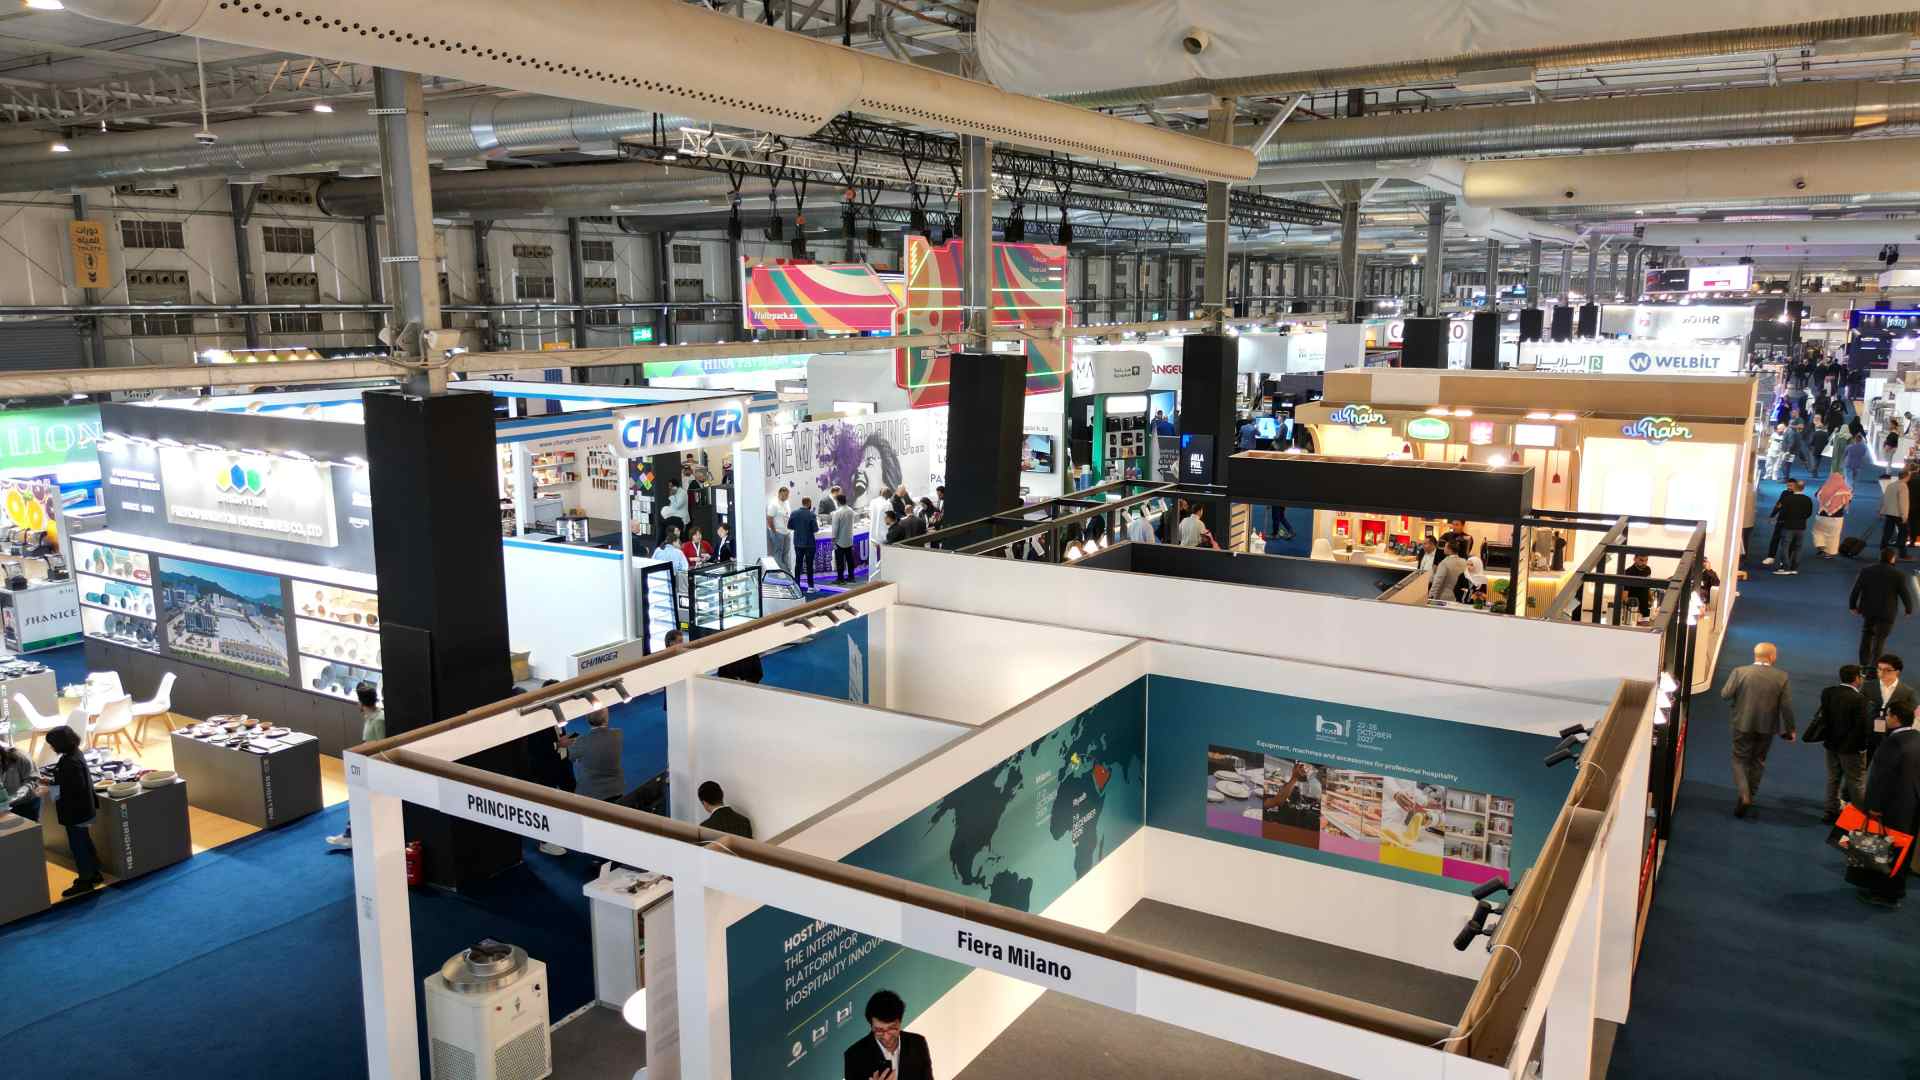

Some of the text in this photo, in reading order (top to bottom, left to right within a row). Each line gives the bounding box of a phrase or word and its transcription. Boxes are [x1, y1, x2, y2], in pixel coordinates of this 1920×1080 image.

[622, 408, 743, 449] CHANGER
[764, 428, 813, 477] NEW
[25, 609, 77, 626] SHANICE
[580, 650, 618, 669] CHANGER
[1422, 768, 1458, 782] hospitality
[467, 793, 550, 832] PRINCIPESSA
[784, 923, 814, 953] HOST
[958, 930, 1072, 981] Fiera Milano
[785, 949, 804, 972] THE
[785, 932, 859, 992] PLATFORM FOR
[786, 959, 847, 1011] HOSPITALITY
